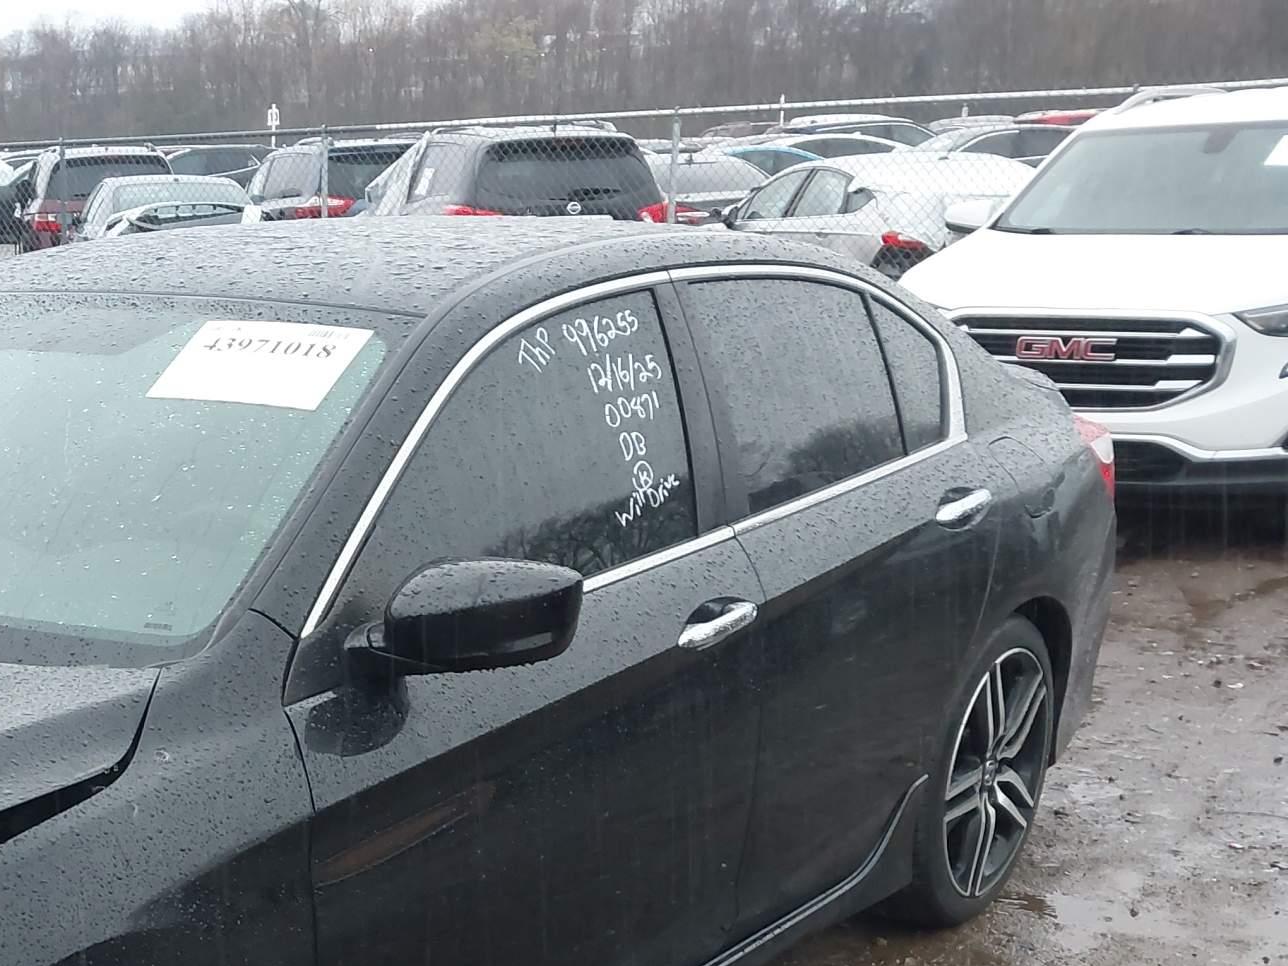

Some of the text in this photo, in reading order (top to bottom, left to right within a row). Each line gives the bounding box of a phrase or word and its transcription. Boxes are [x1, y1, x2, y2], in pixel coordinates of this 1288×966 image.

[562, 310, 638, 355] 996255
[203, 337, 336, 359] 43971018
[1015, 336, 1118, 362] GMC
[588, 353, 662, 393] 12/16/25
[619, 431, 647, 461] DB
